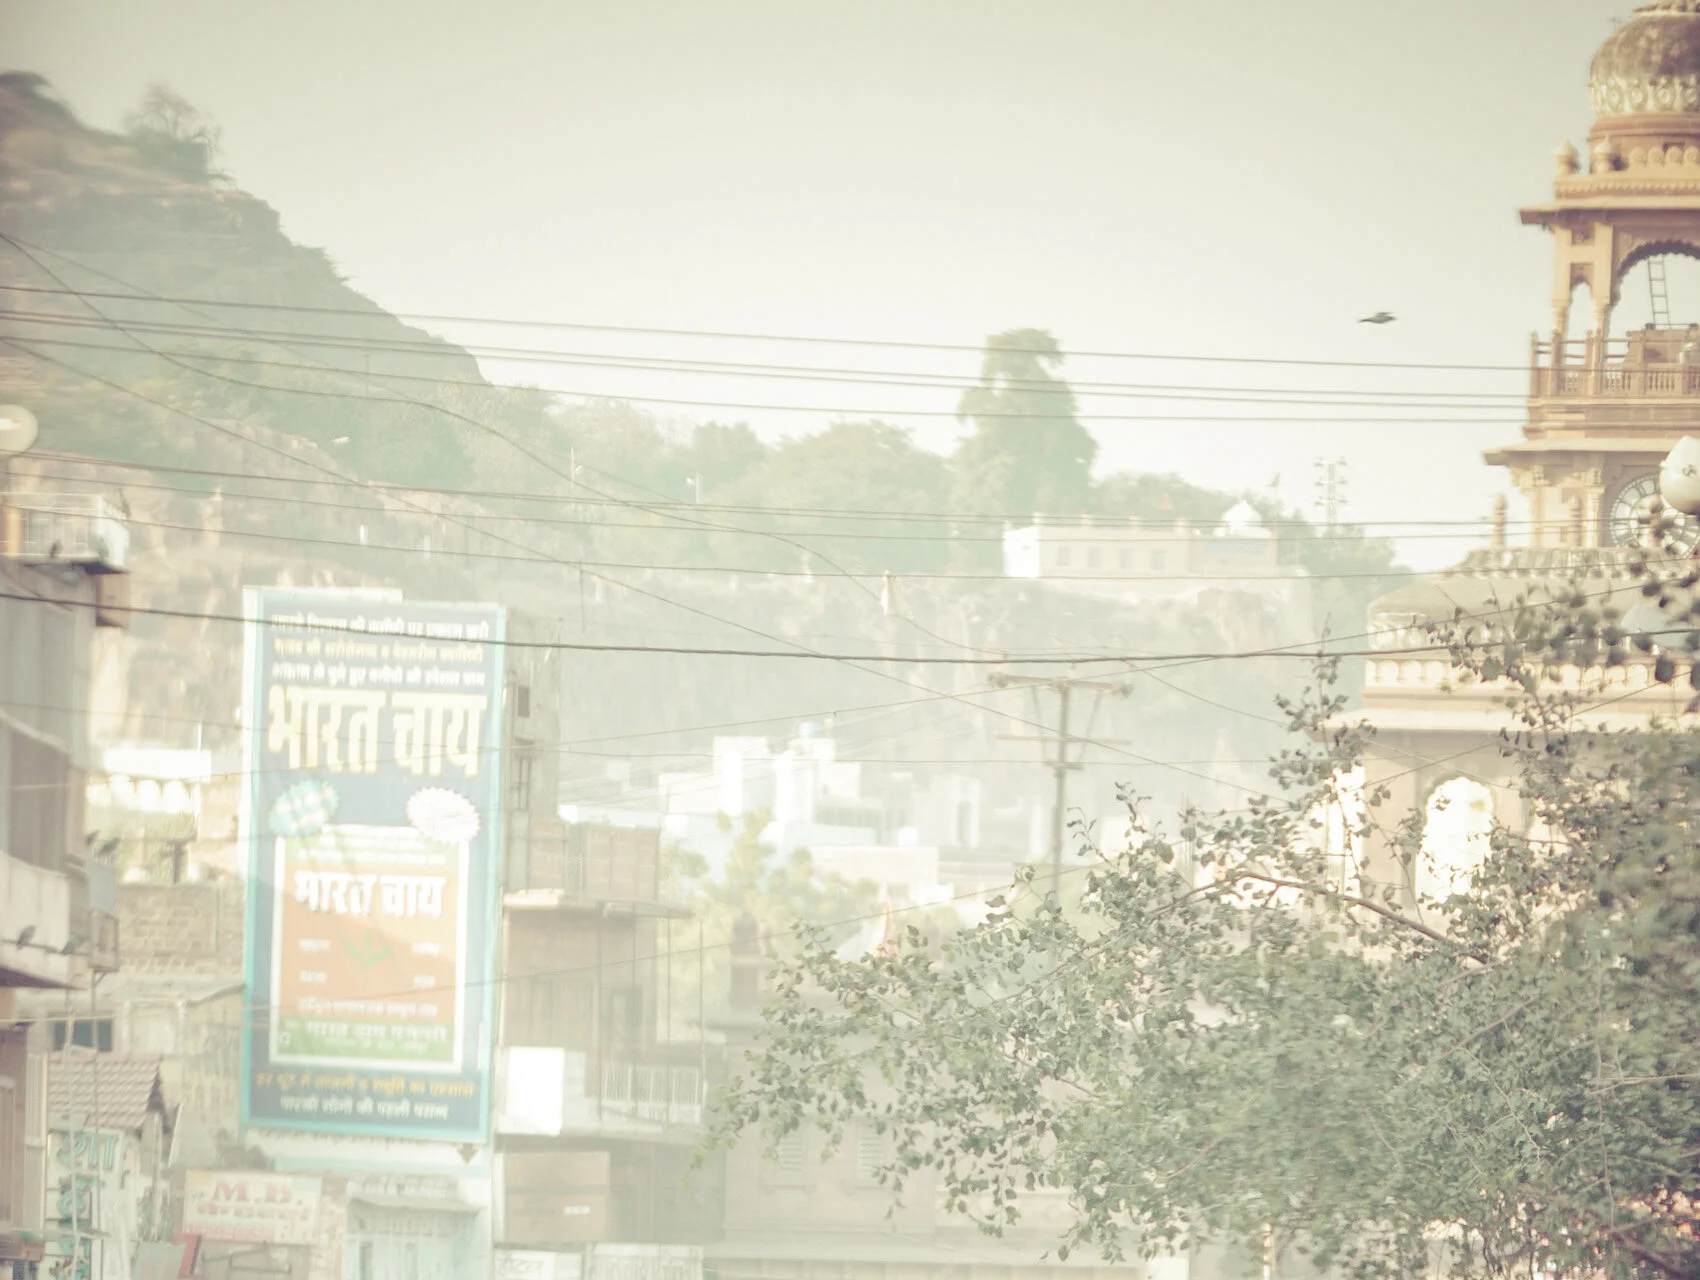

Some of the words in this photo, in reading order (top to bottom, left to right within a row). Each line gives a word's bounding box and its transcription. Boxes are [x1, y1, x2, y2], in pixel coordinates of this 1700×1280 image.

[267, 684, 387, 773] भारत
[391, 691, 488, 777] चाय
[292, 870, 378, 916] भारत
[379, 875, 447, 919] चाय
